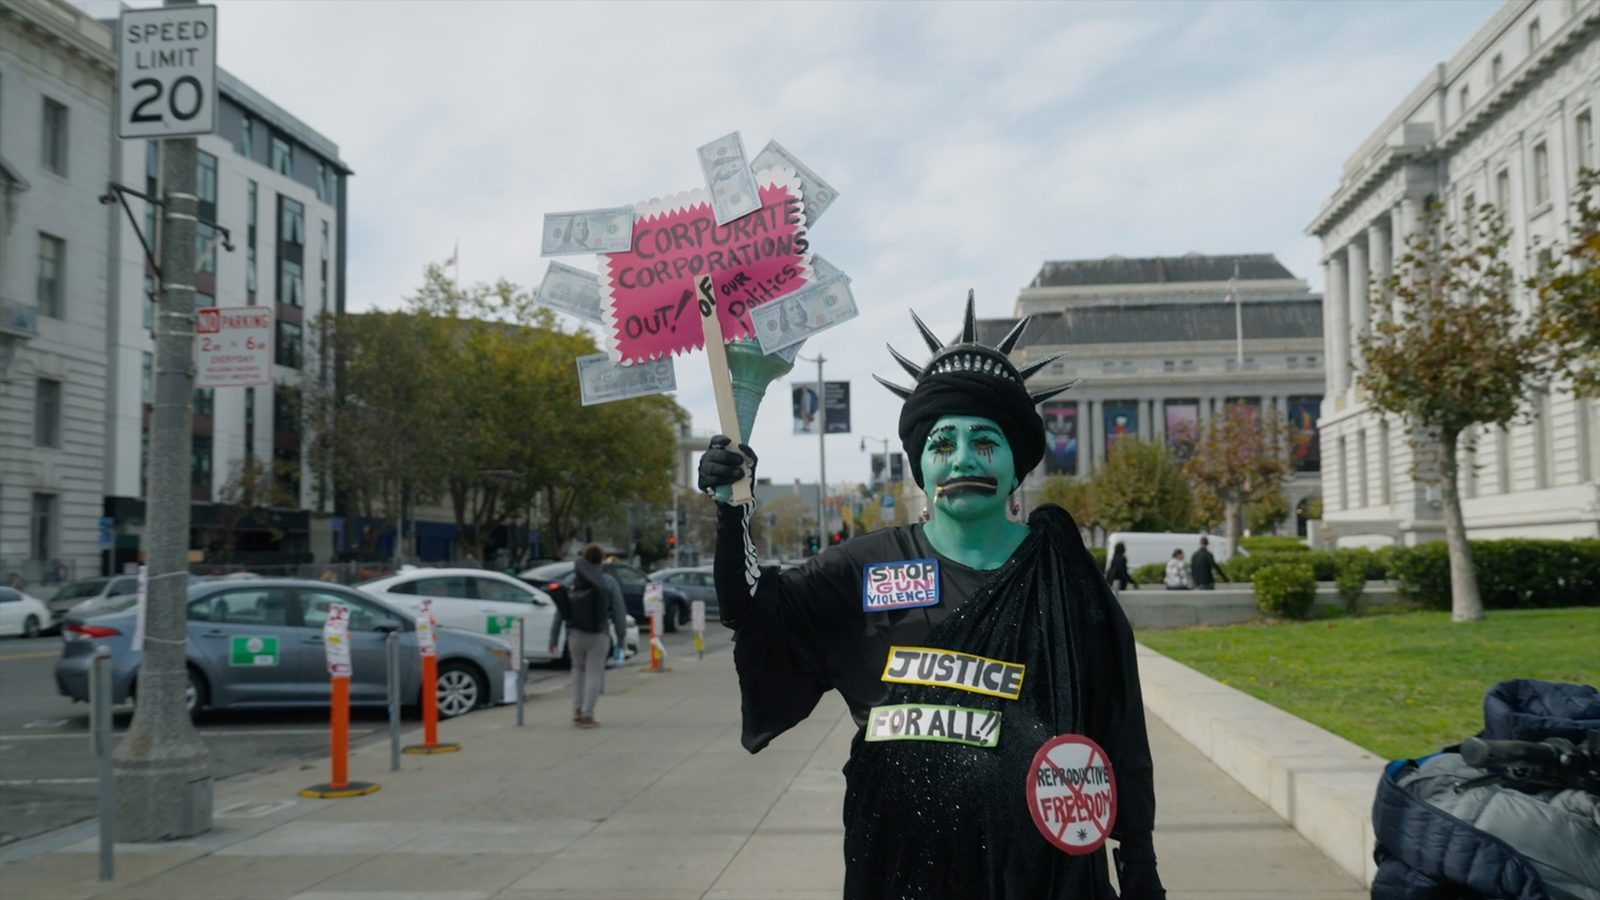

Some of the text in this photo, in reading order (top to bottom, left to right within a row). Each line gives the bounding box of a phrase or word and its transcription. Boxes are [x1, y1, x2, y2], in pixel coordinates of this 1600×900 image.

[128, 20, 208, 43] SPEED
[135, 47, 199, 69] LIMIT
[130, 75, 204, 123] 20
[618, 231, 809, 289] CORPORATIONS
[698, 276, 716, 318] OF
[721, 271, 752, 297] OUR
[199, 312, 269, 332] NO PARKING
[625, 289, 693, 340] OUT!
[871, 563, 934, 582] STOP
[868, 589, 935, 604] VIOLENCE
[876, 580, 931, 594] GUN
[888, 650, 1023, 695] JUSTICE
[871, 708, 1001, 745] FOR ALL!!
[1037, 765, 1109, 788] REPRODUCTIVE
[1040, 790, 1111, 823] FREEDOM
